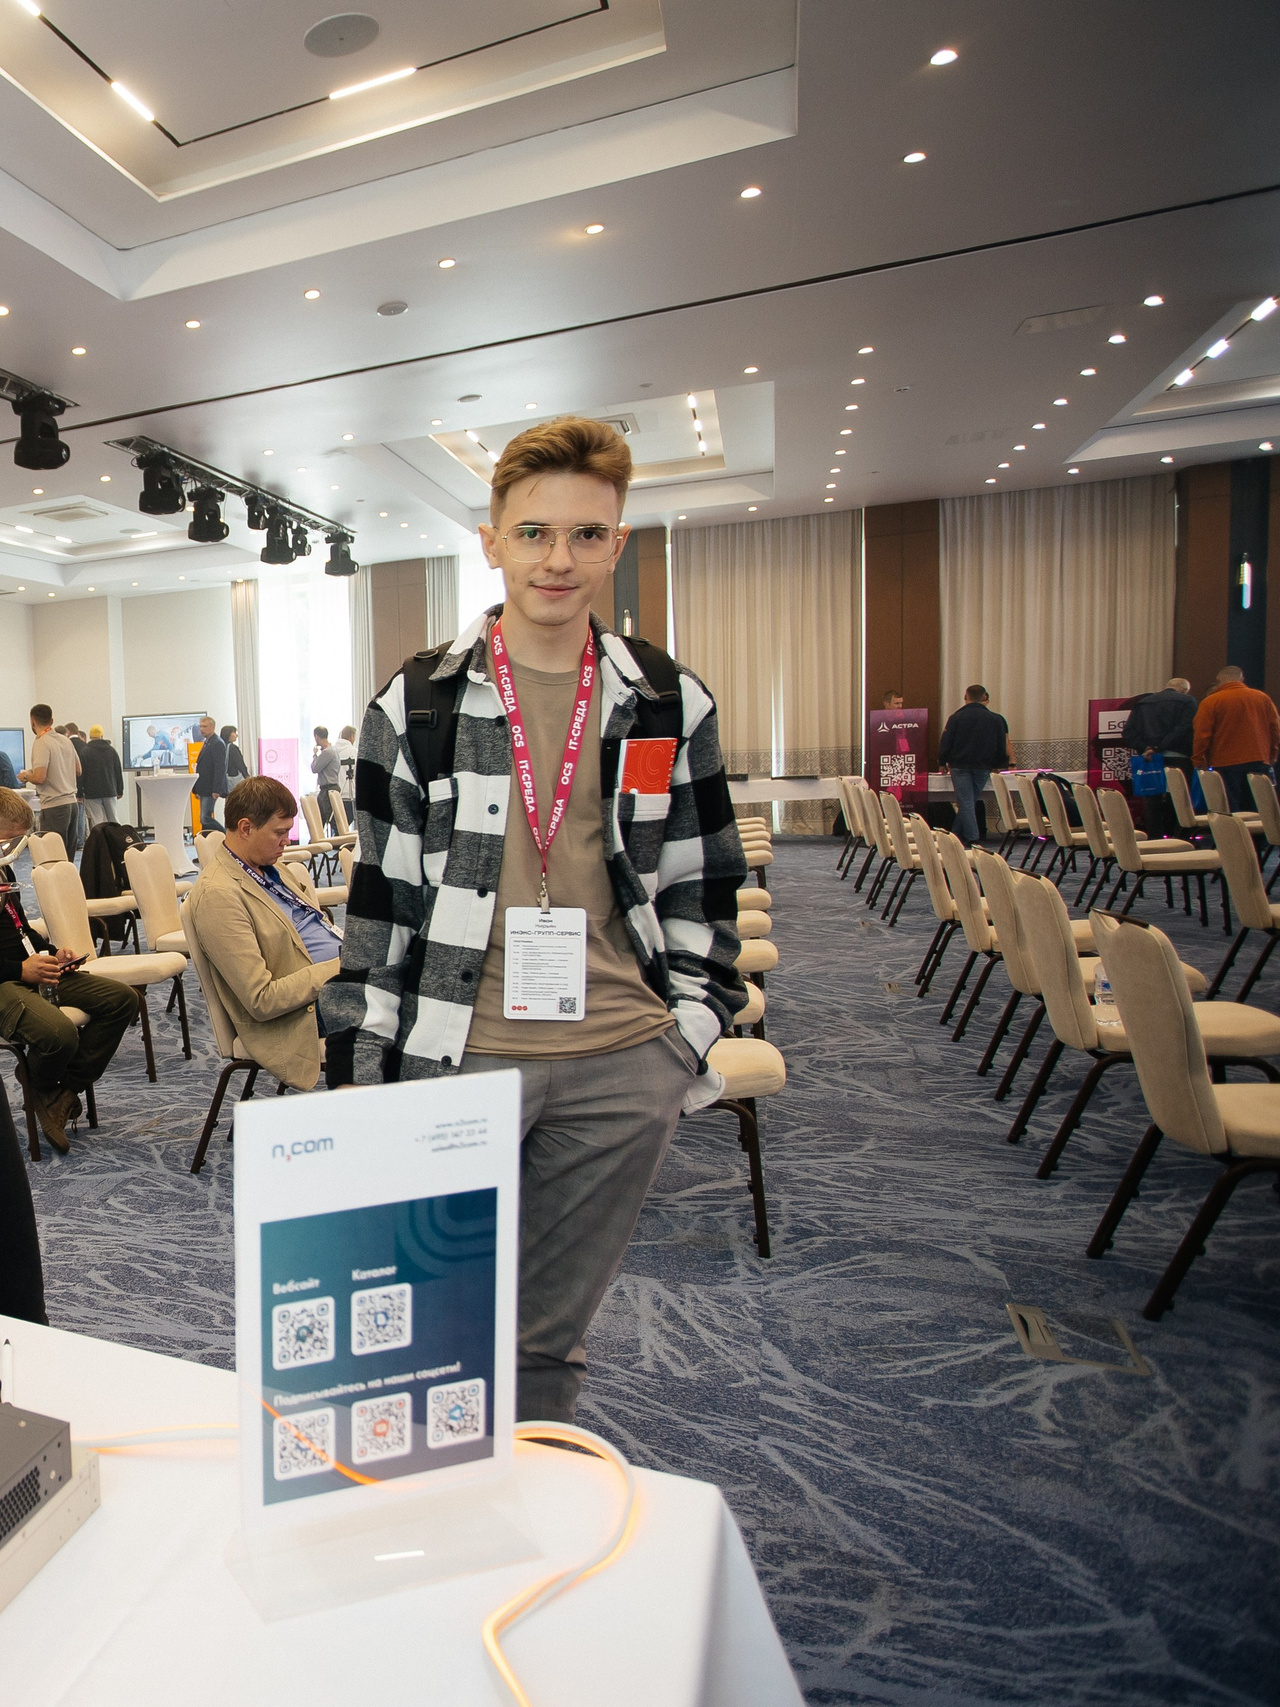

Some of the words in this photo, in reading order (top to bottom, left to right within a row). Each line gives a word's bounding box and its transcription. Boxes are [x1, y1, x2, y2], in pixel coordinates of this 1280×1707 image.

[493, 635, 503, 656] OCS
[582, 665, 593, 687] OCS
[498, 664, 517, 713] IT-СРЕДА
[511, 725, 525, 748] OCS
[568, 700, 588, 750] IT-СРЕДА
[561, 762, 574, 785] OCS
[518, 759, 536, 814] IT-СРЕДА
